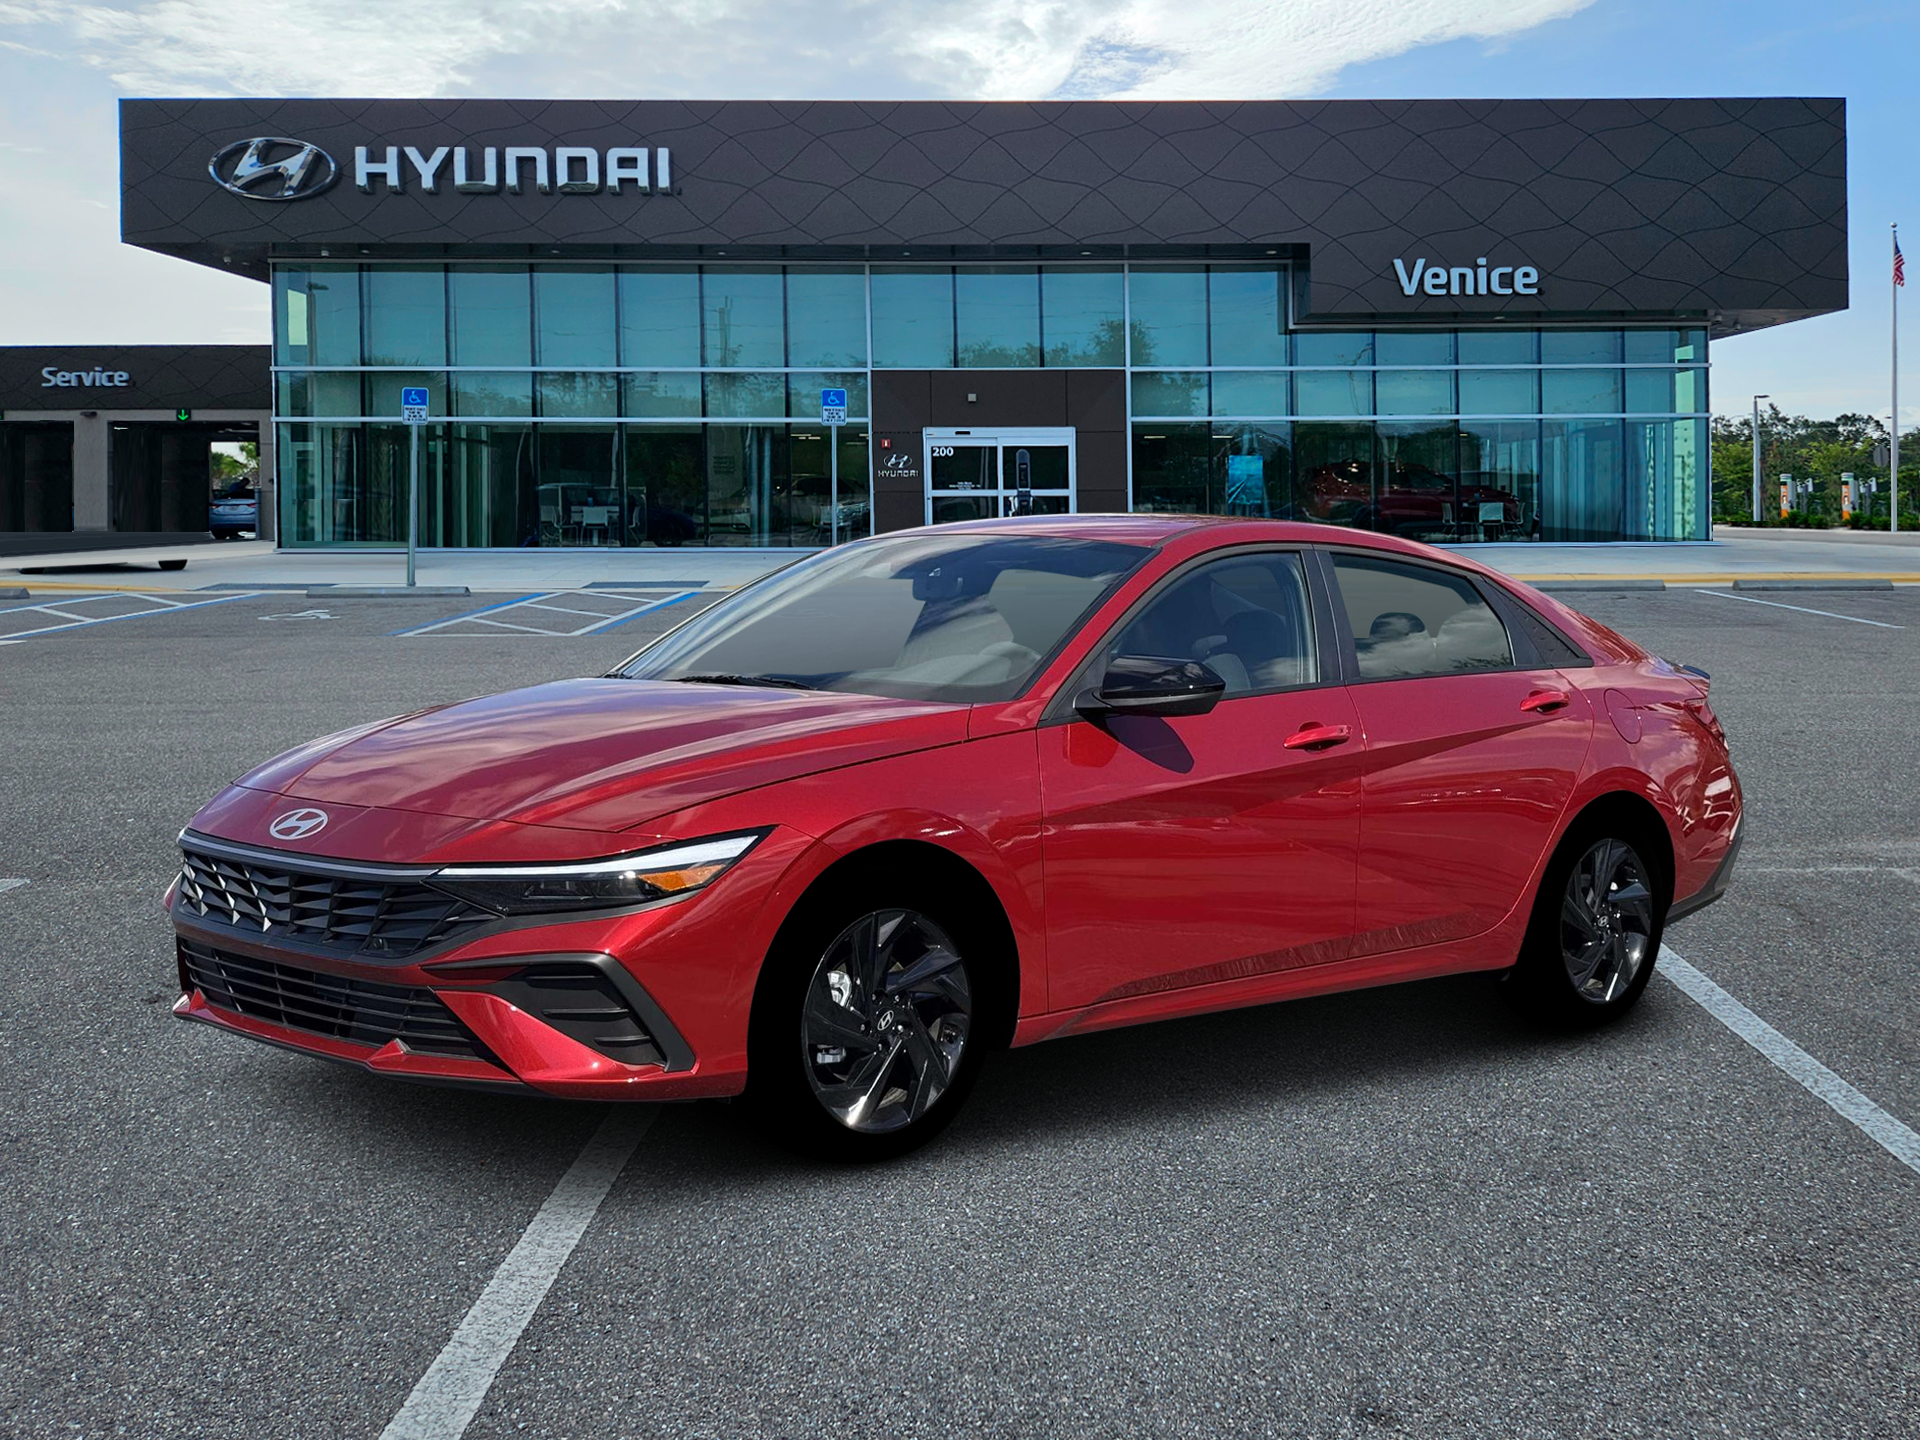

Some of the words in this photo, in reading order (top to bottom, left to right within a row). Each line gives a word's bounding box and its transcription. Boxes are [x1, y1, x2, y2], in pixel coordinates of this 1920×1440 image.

[354, 146, 672, 194] HYUNDAI
[1392, 256, 1540, 296] Venice
[41, 366, 130, 388] Service
[932, 446, 954, 457] 200
[877, 470, 919, 478] HYUNDAI
